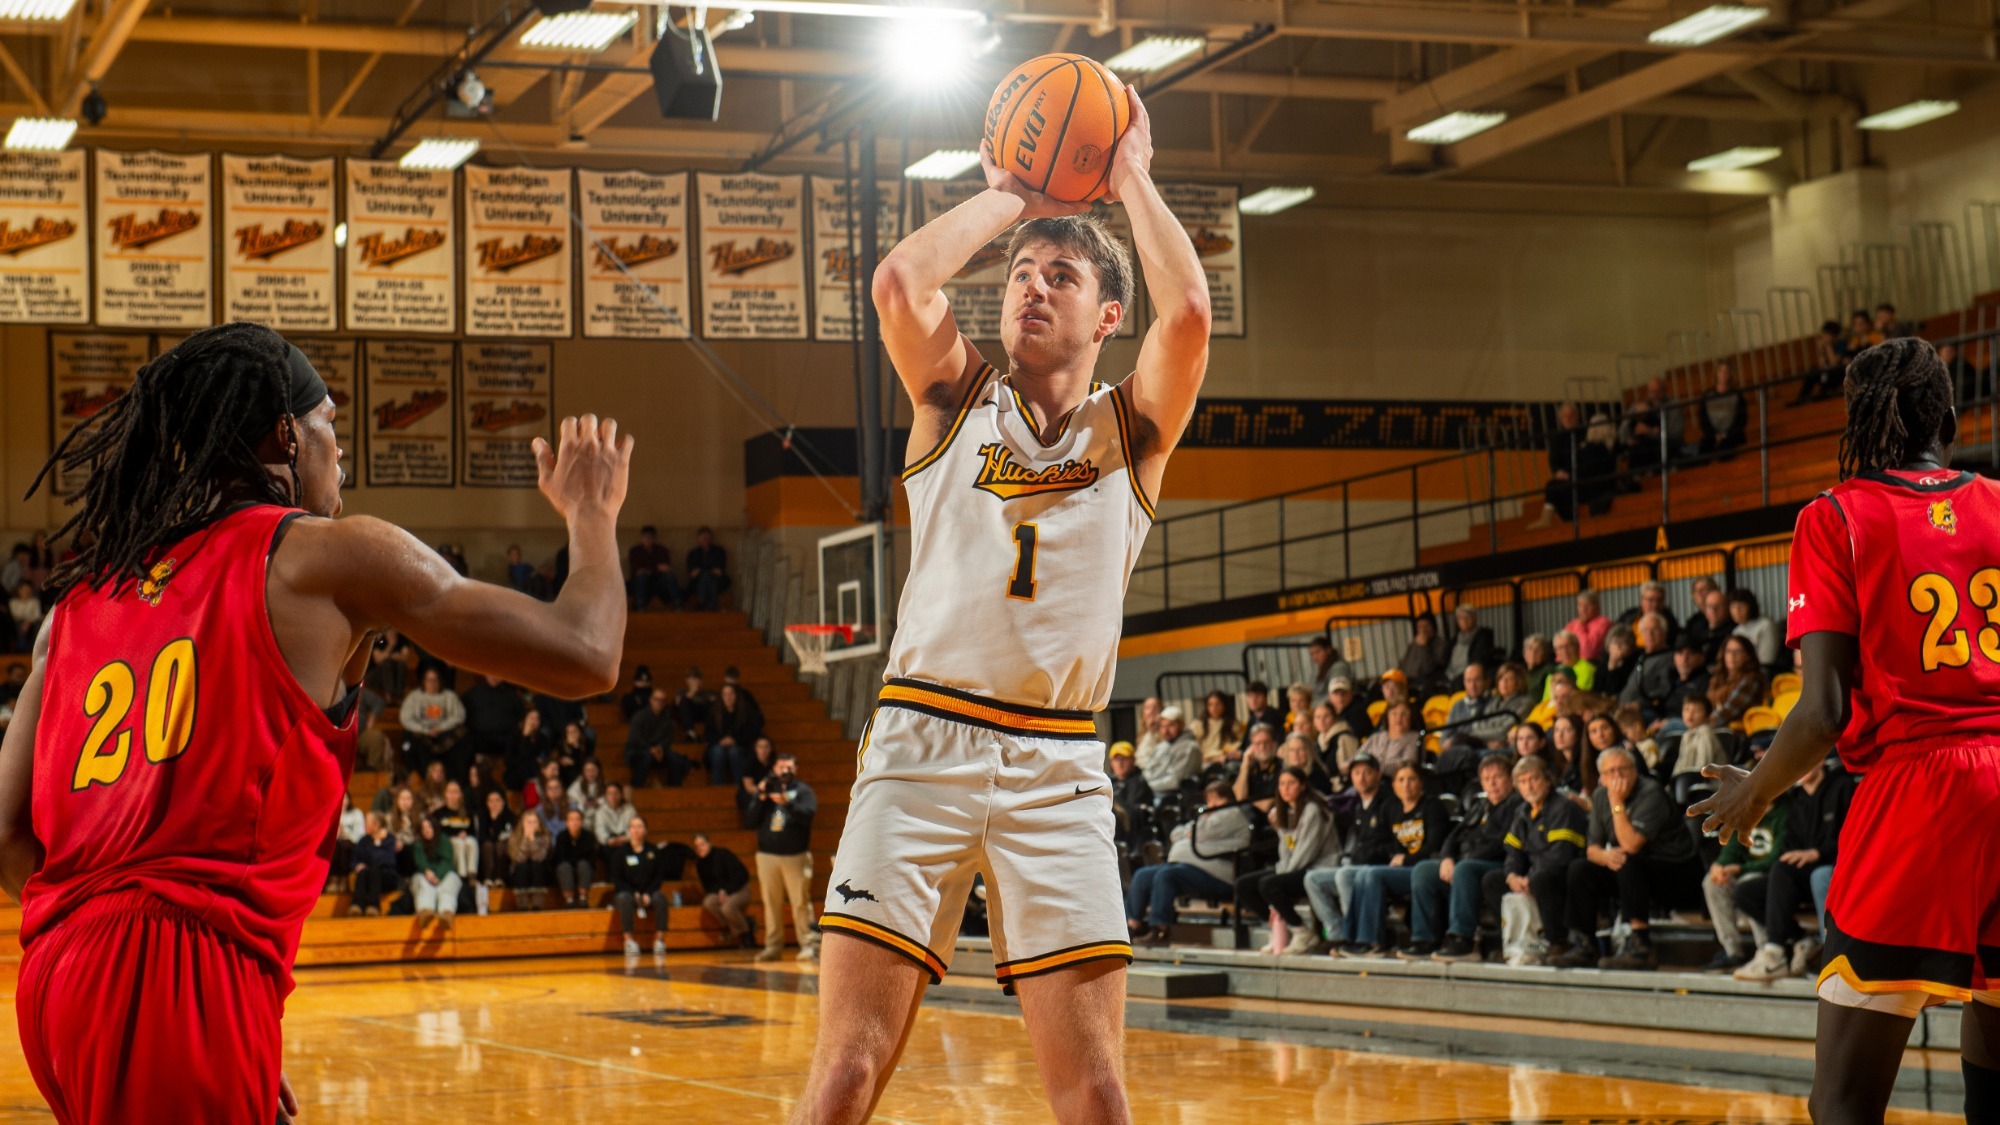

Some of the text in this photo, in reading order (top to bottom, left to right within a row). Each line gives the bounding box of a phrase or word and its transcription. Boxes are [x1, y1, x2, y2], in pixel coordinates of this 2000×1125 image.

[1015, 109, 1047, 172] EVO
[121, 156, 187, 169] Michigan
[247, 162, 312, 175] Michigan
[104, 168, 205, 186] Technological
[232, 174, 330, 191] Technological
[370, 166, 432, 182] Michigan
[488, 173, 549, 188] Michigan
[353, 178, 448, 200] Technological
[603, 176, 666, 192] Michigan
[721, 178, 781, 193] Michigan
[1164, 187, 1217, 199] Michigan
[116, 186, 191, 202] University
[243, 192, 315, 208] University
[471, 188, 565, 207] Technological
[588, 190, 681, 210] Technological
[705, 192, 796, 211] Technological
[366, 200, 436, 218] University
[484, 207, 553, 225] University
[601, 209, 669, 227] University
[107, 207, 202, 251] Huskies
[718, 211, 784, 229] University
[235, 218, 326, 262] Huskies
[356, 226, 447, 270] Huskies
[475, 234, 564, 274] Huskies
[591, 234, 679, 274] Huskies
[708, 237, 795, 277] Huskies
[973, 443, 1099, 490] Huskies
[1006, 520, 1039, 602] 1
[1907, 566, 2000, 674] 23
[71, 636, 199, 793] 20
